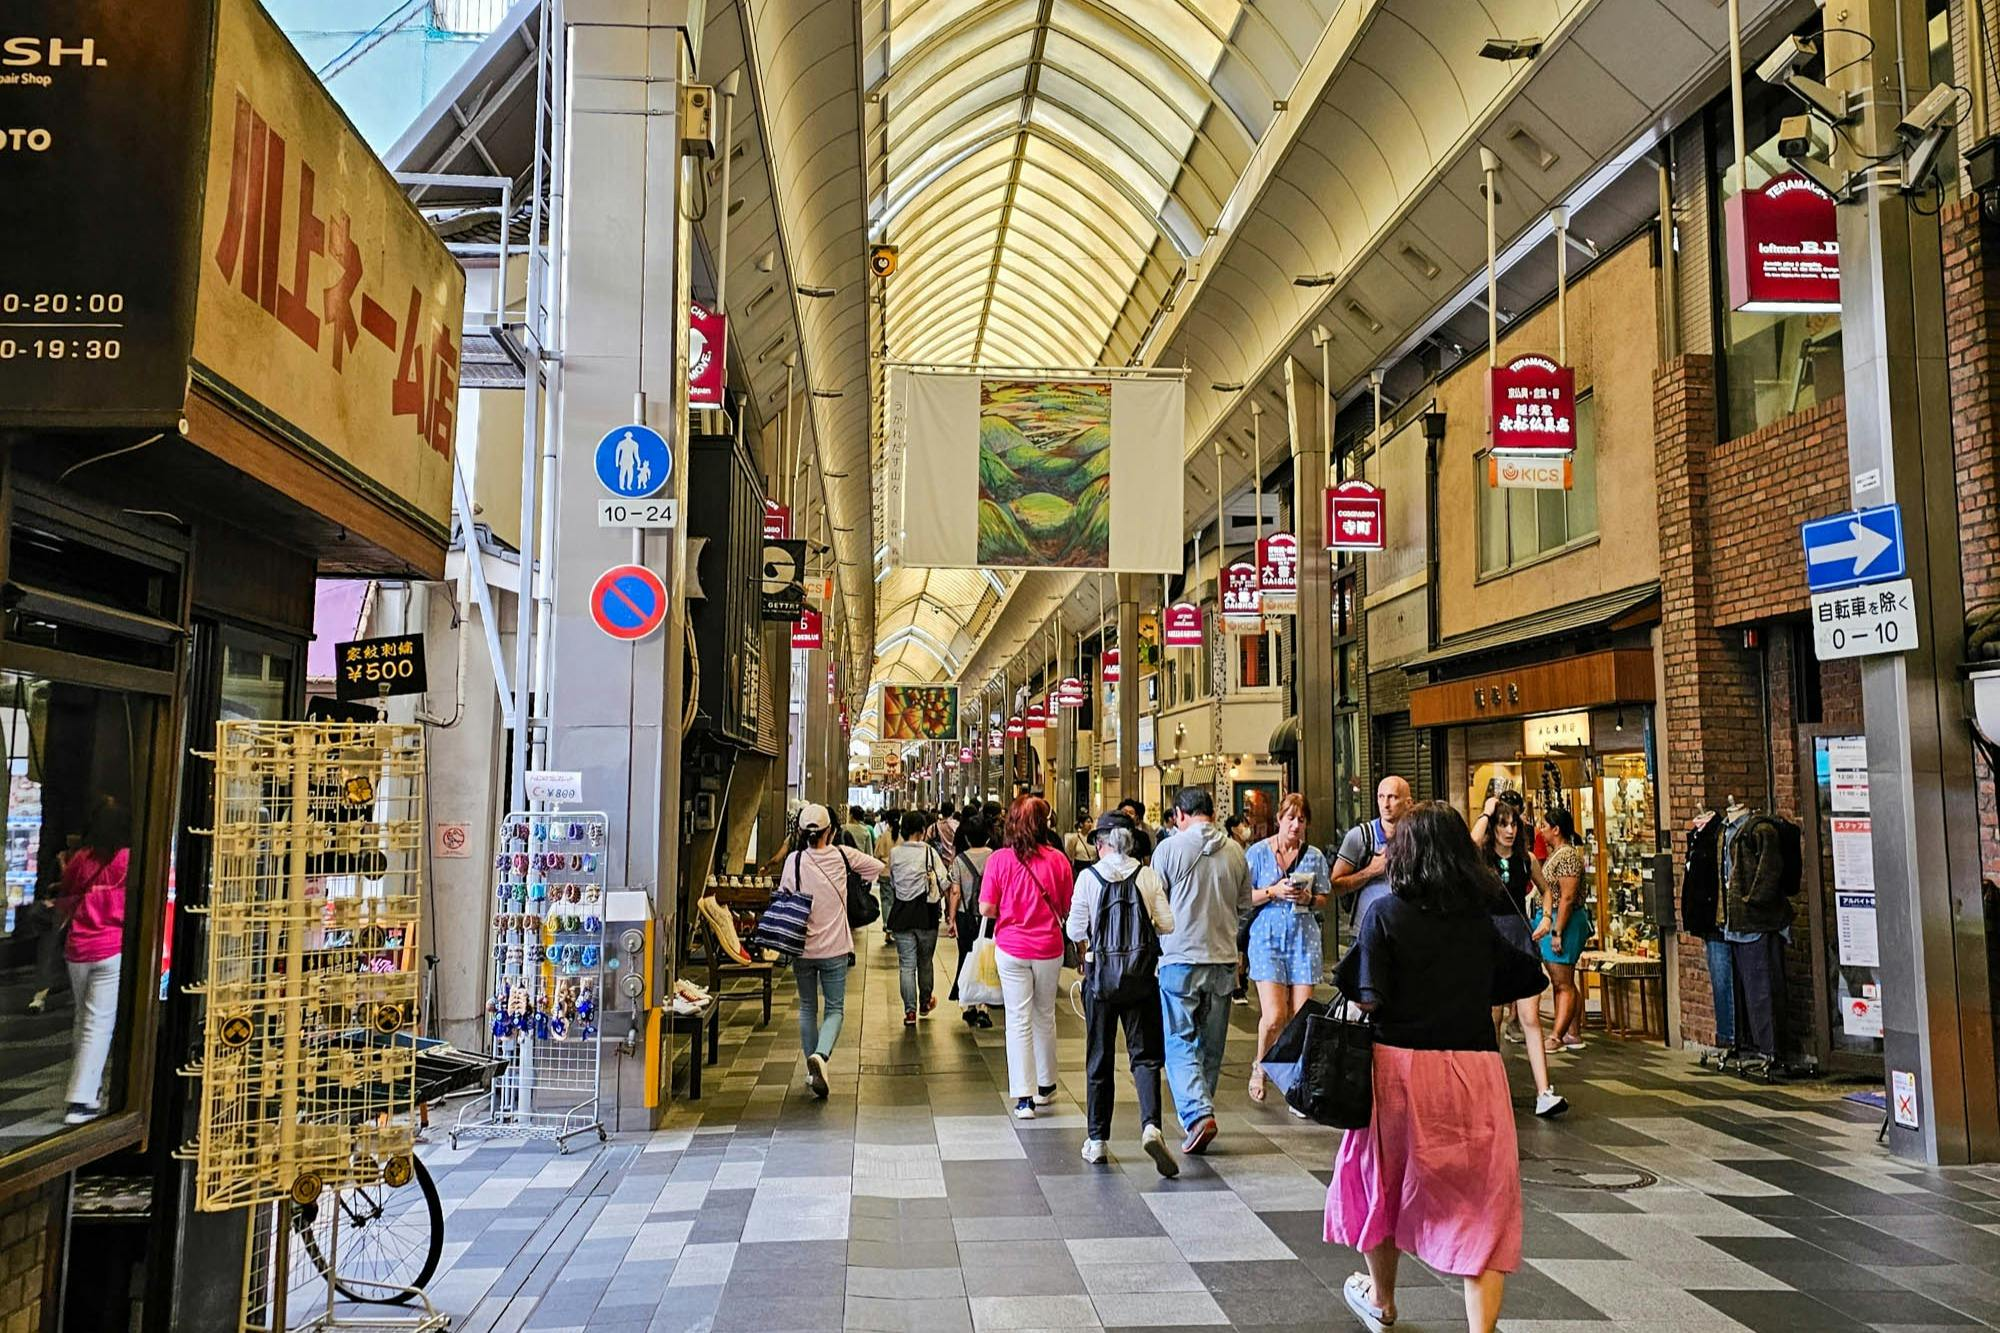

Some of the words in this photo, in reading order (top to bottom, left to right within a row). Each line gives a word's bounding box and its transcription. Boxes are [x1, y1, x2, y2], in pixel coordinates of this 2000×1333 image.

[21, 72, 52, 87] Shop
[0, 128, 52, 151] TO
[1764, 179, 1837, 206] TERAMAC
[1758, 242, 1800, 254] loftman
[215, 87, 457, 462] 川上ネーム店
[3, 293, 124, 313] 0-20:00
[0, 340, 121, 359] 0-19:30
[1509, 357, 1557, 373] TERAMACHI
[1521, 467, 1559, 482] KICS
[1818, 591, 1910, 622] 自転車を除く
[345, 659, 414, 683] ¥500
